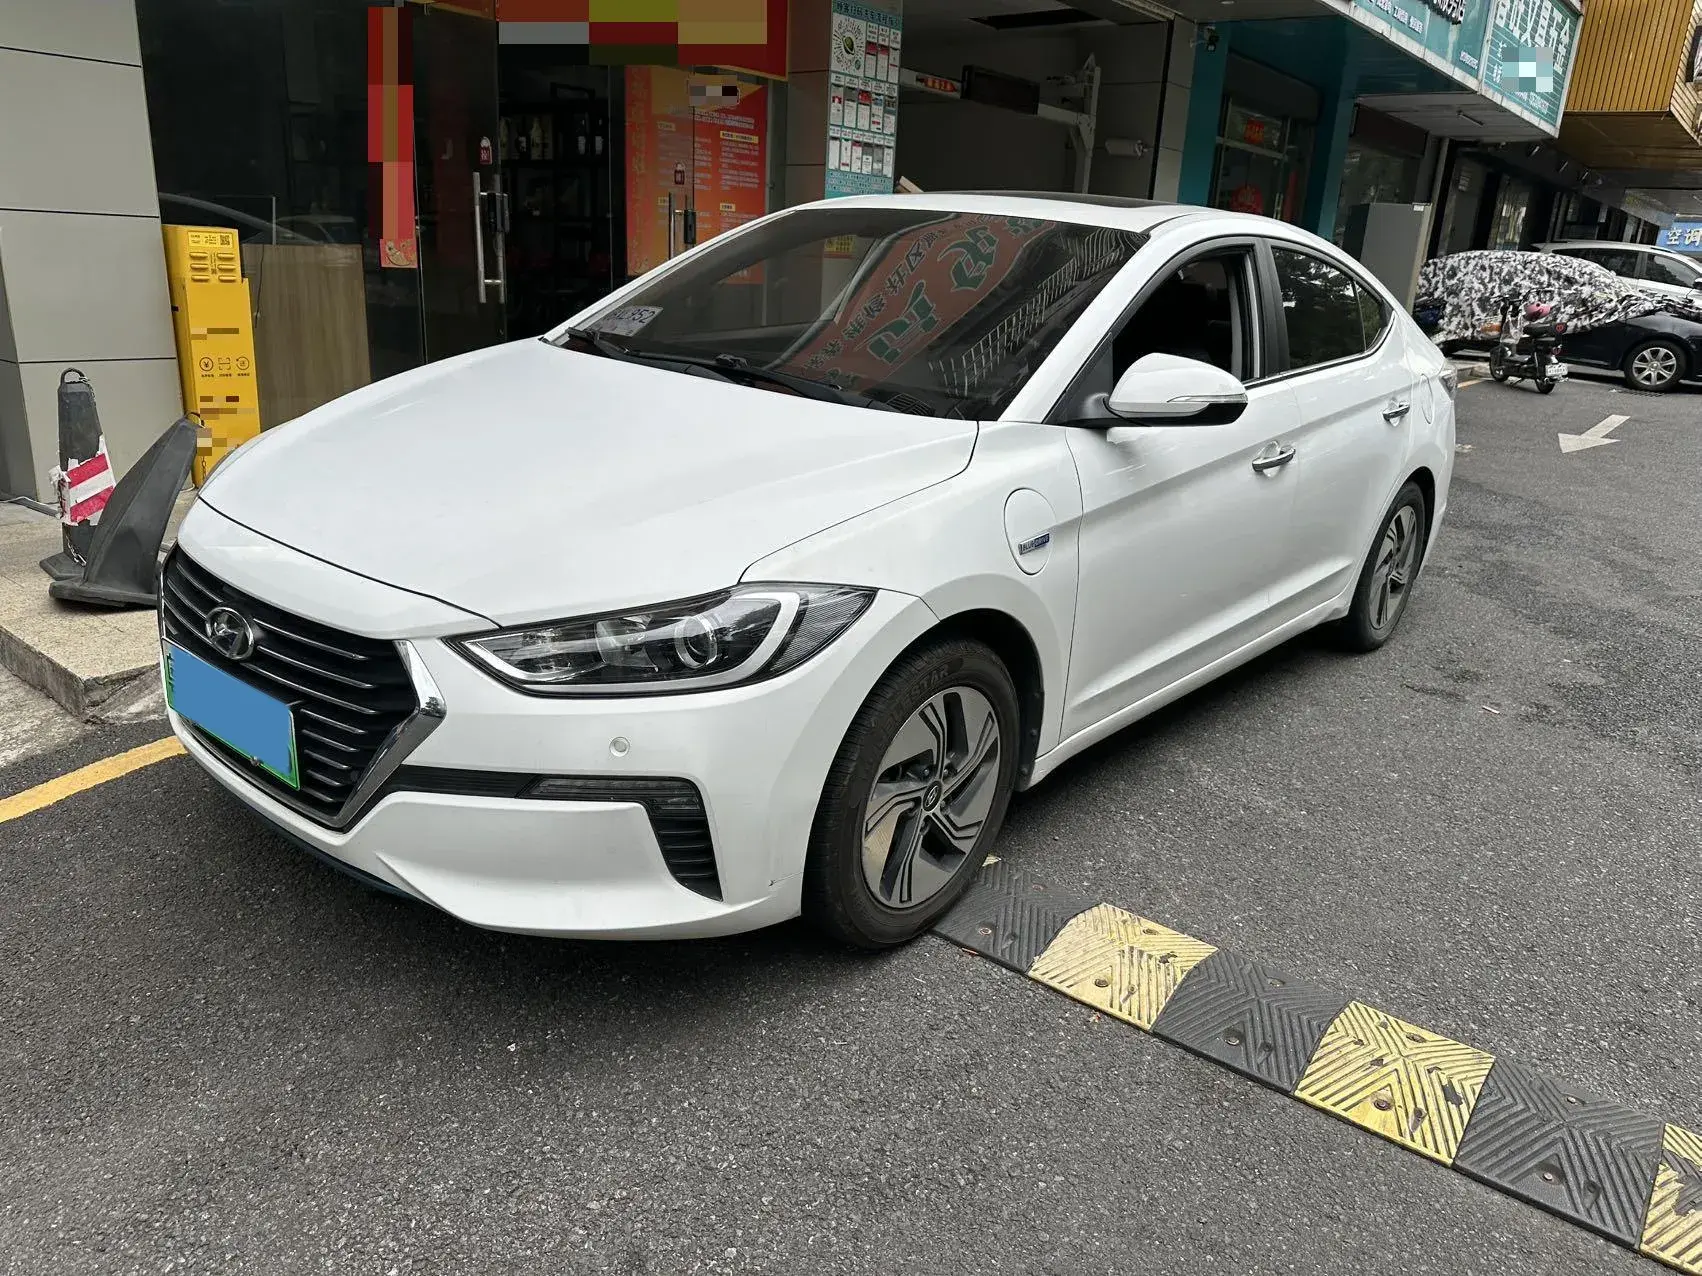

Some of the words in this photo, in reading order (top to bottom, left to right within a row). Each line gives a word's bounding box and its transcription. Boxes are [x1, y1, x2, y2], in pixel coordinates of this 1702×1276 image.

[1495, 0, 1572, 75] 文具五金
[1666, 227, 1702, 247] 空调
